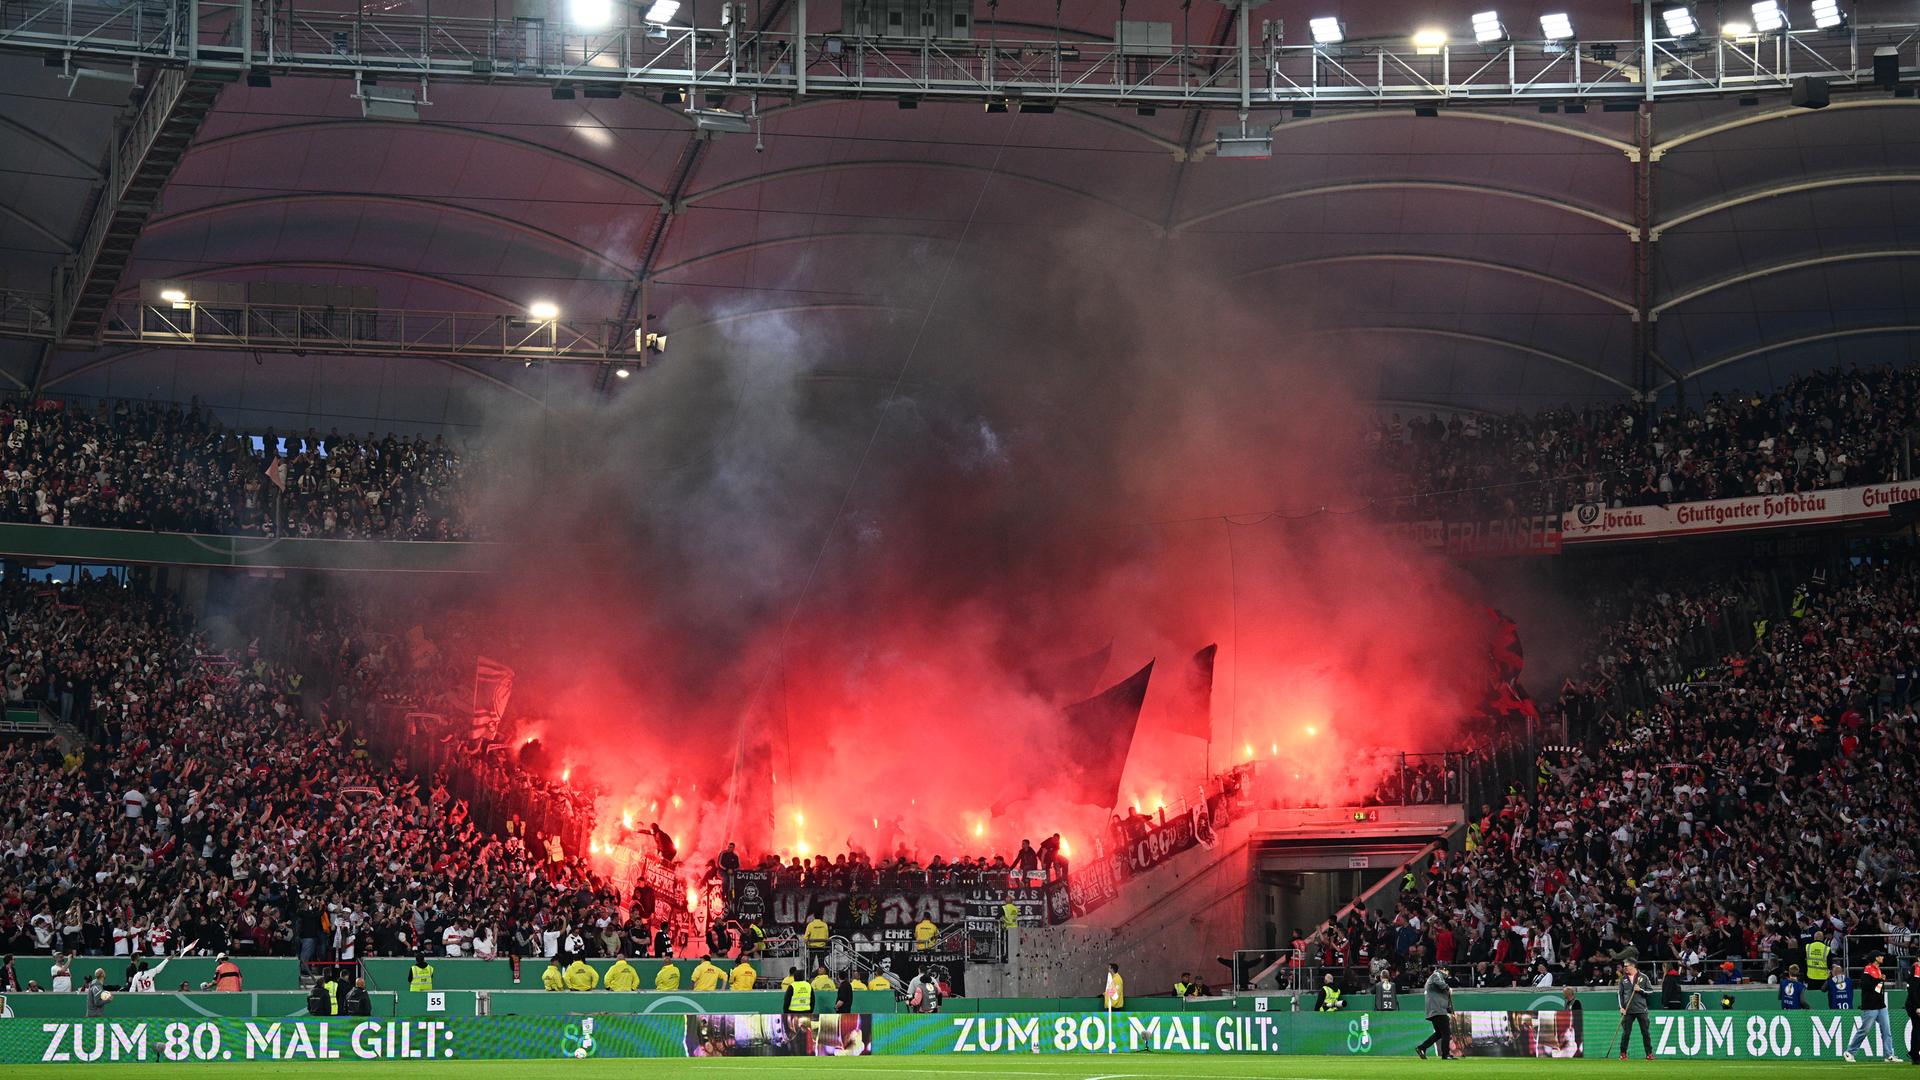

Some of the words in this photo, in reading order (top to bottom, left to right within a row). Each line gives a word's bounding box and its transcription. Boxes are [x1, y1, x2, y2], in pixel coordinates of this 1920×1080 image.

[1862, 487, 1920, 507] Stuttga
[1677, 501, 1760, 524] Stuttgarter
[1764, 494, 1825, 519] Hofbräu
[1448, 515, 1558, 553] ERLENSEE
[1369, 811, 1376, 821] 4
[972, 889, 1039, 900] ULTRAS
[977, 905, 1033, 916] NEER
[430, 997, 442, 1006] 55
[1257, 1002, 1266, 1010] 71
[1383, 1001, 1392, 1009] 52
[42, 1023, 148, 1061] ZUM
[164, 1022, 232, 1061] 80.
[245, 1022, 340, 1059] MAL
[352, 1021, 454, 1058] GILT:
[953, 1017, 1040, 1052] ZUM
[1054, 1016, 1117, 1051] 80.
[1128, 1016, 1210, 1050] MAL
[1215, 1016, 1279, 1051] GILT:
[1655, 1016, 1735, 1056] ZUM
[1746, 1015, 1802, 1057] 80.
